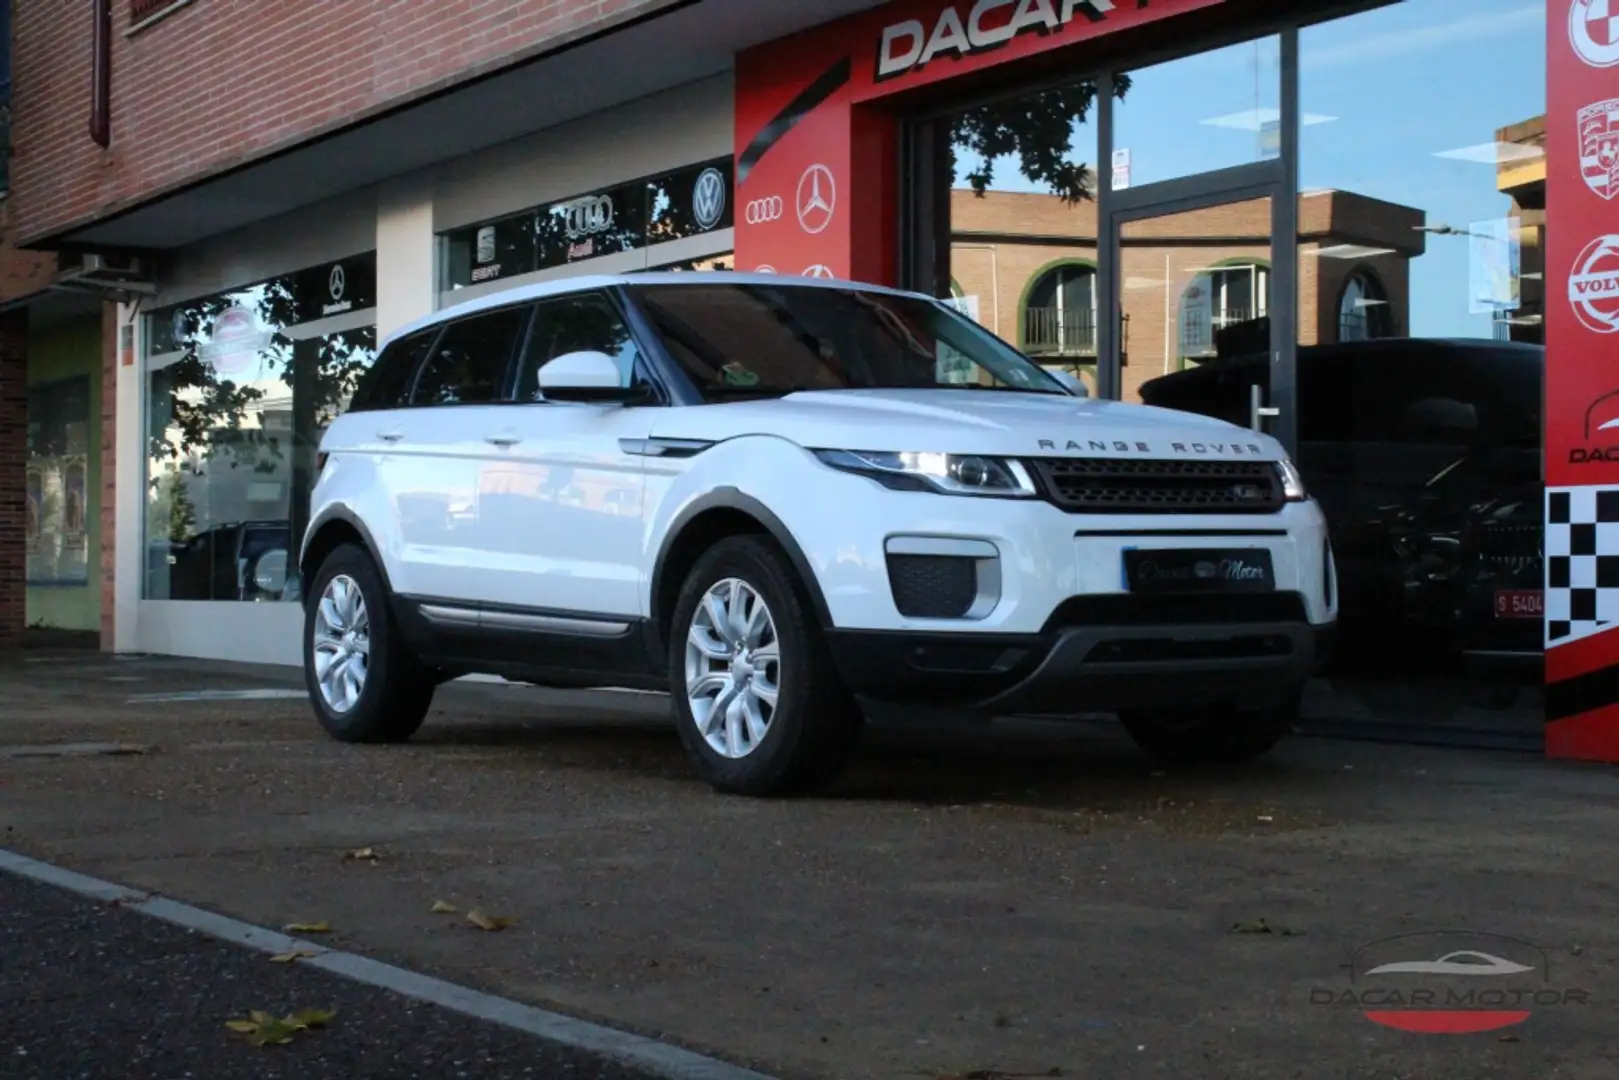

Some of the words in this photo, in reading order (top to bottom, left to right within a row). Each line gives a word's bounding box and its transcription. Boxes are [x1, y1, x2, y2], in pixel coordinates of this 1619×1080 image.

[1574, 278, 1619, 293] VOL
[1037, 439, 1151, 452] RANGE
[1171, 442, 1261, 454] ROVER
